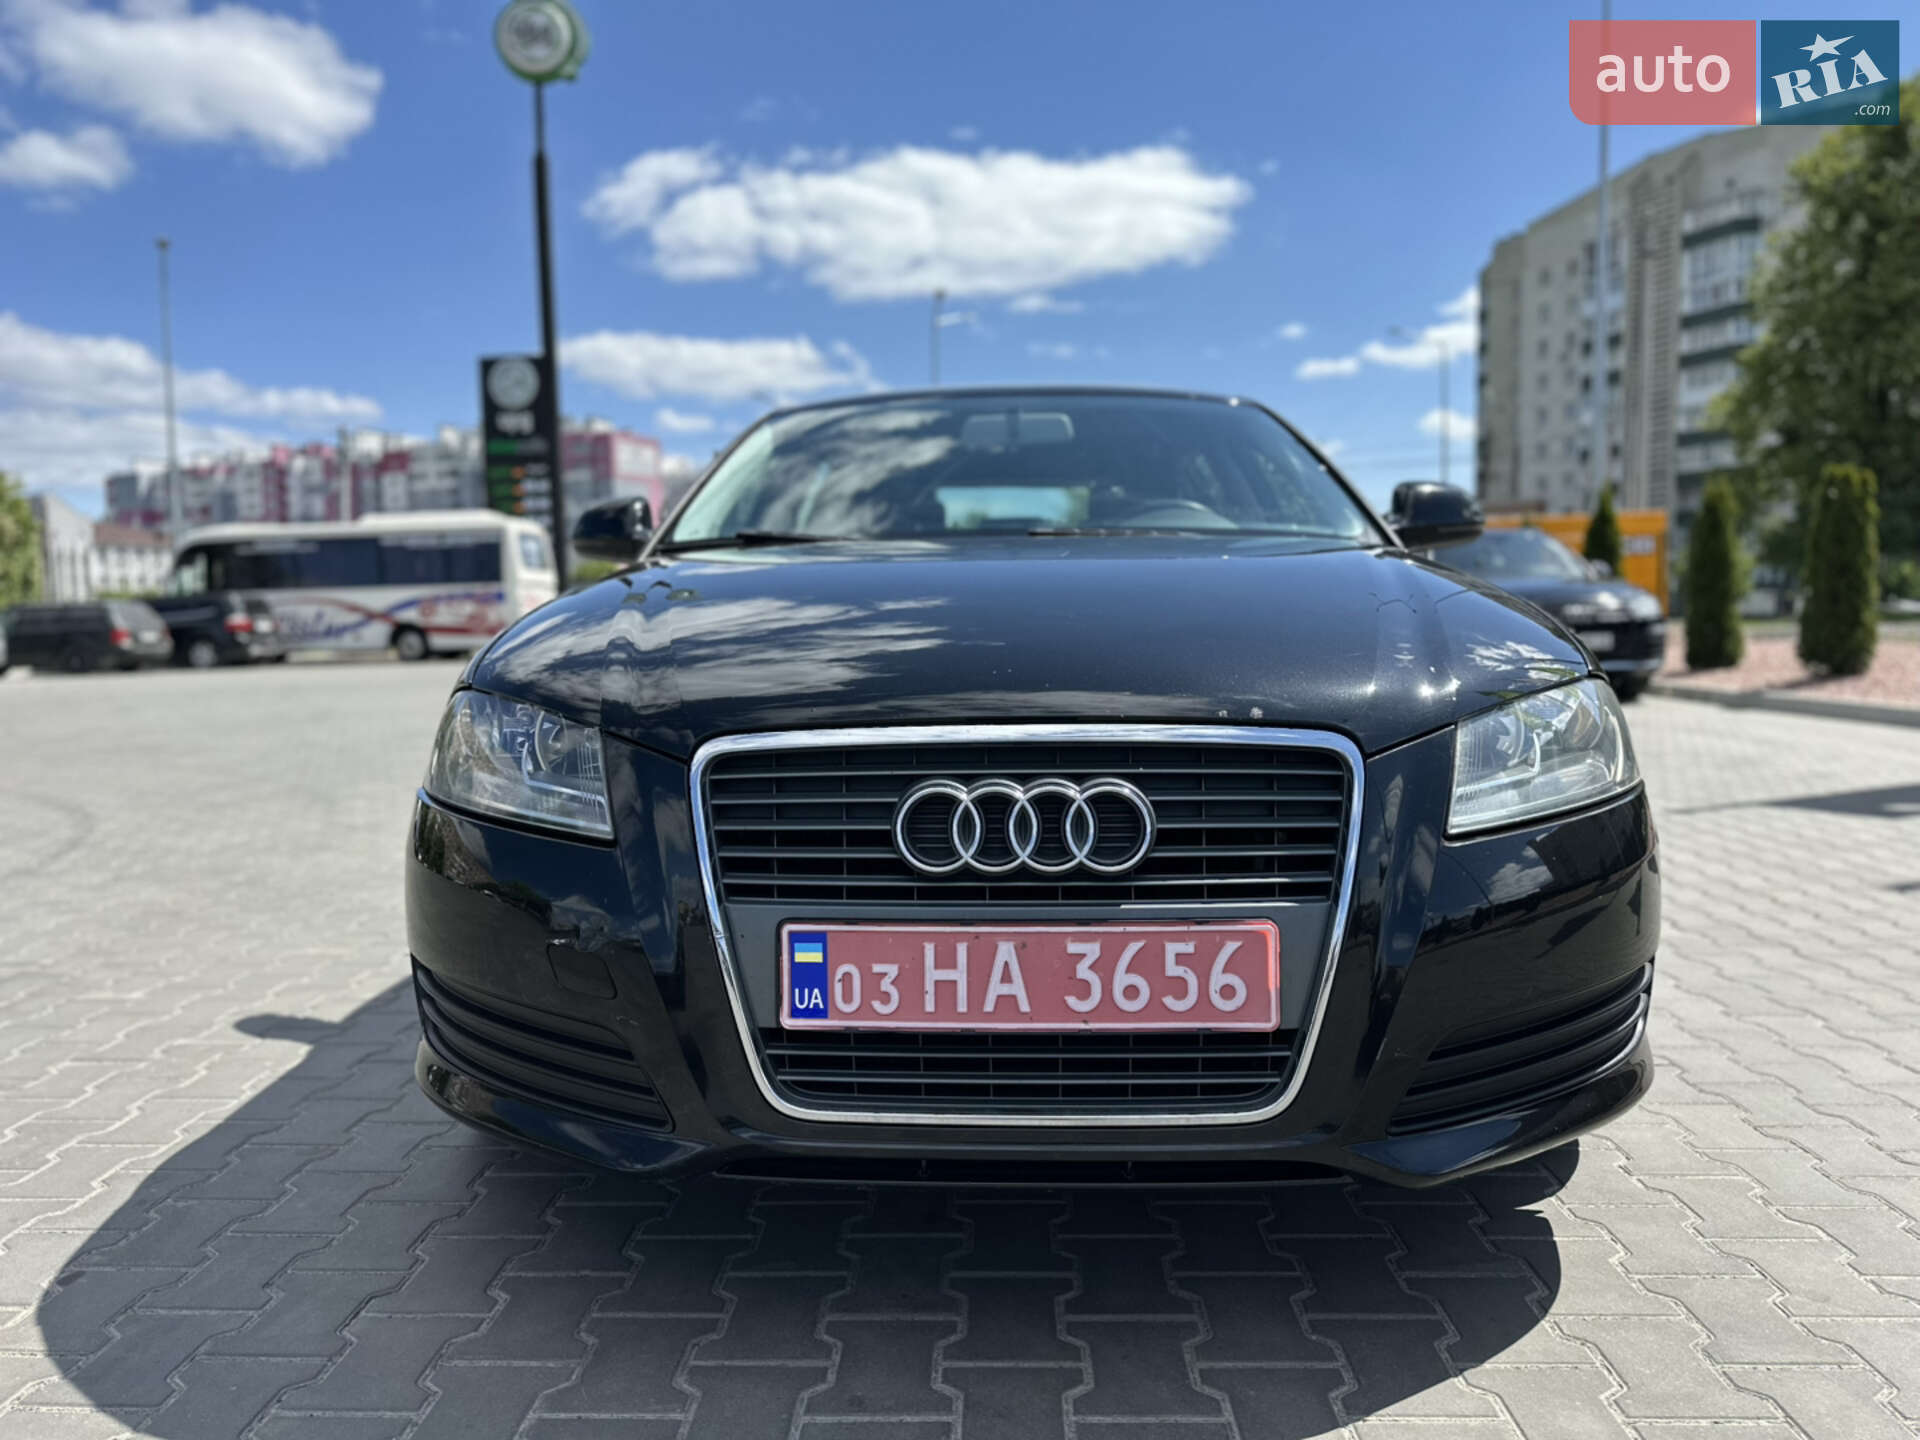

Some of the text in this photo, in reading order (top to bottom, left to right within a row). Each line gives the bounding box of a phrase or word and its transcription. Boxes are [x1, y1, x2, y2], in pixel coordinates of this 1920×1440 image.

[794, 987, 825, 1010] UA
[833, 940, 1248, 1015] 03 HA 3656
